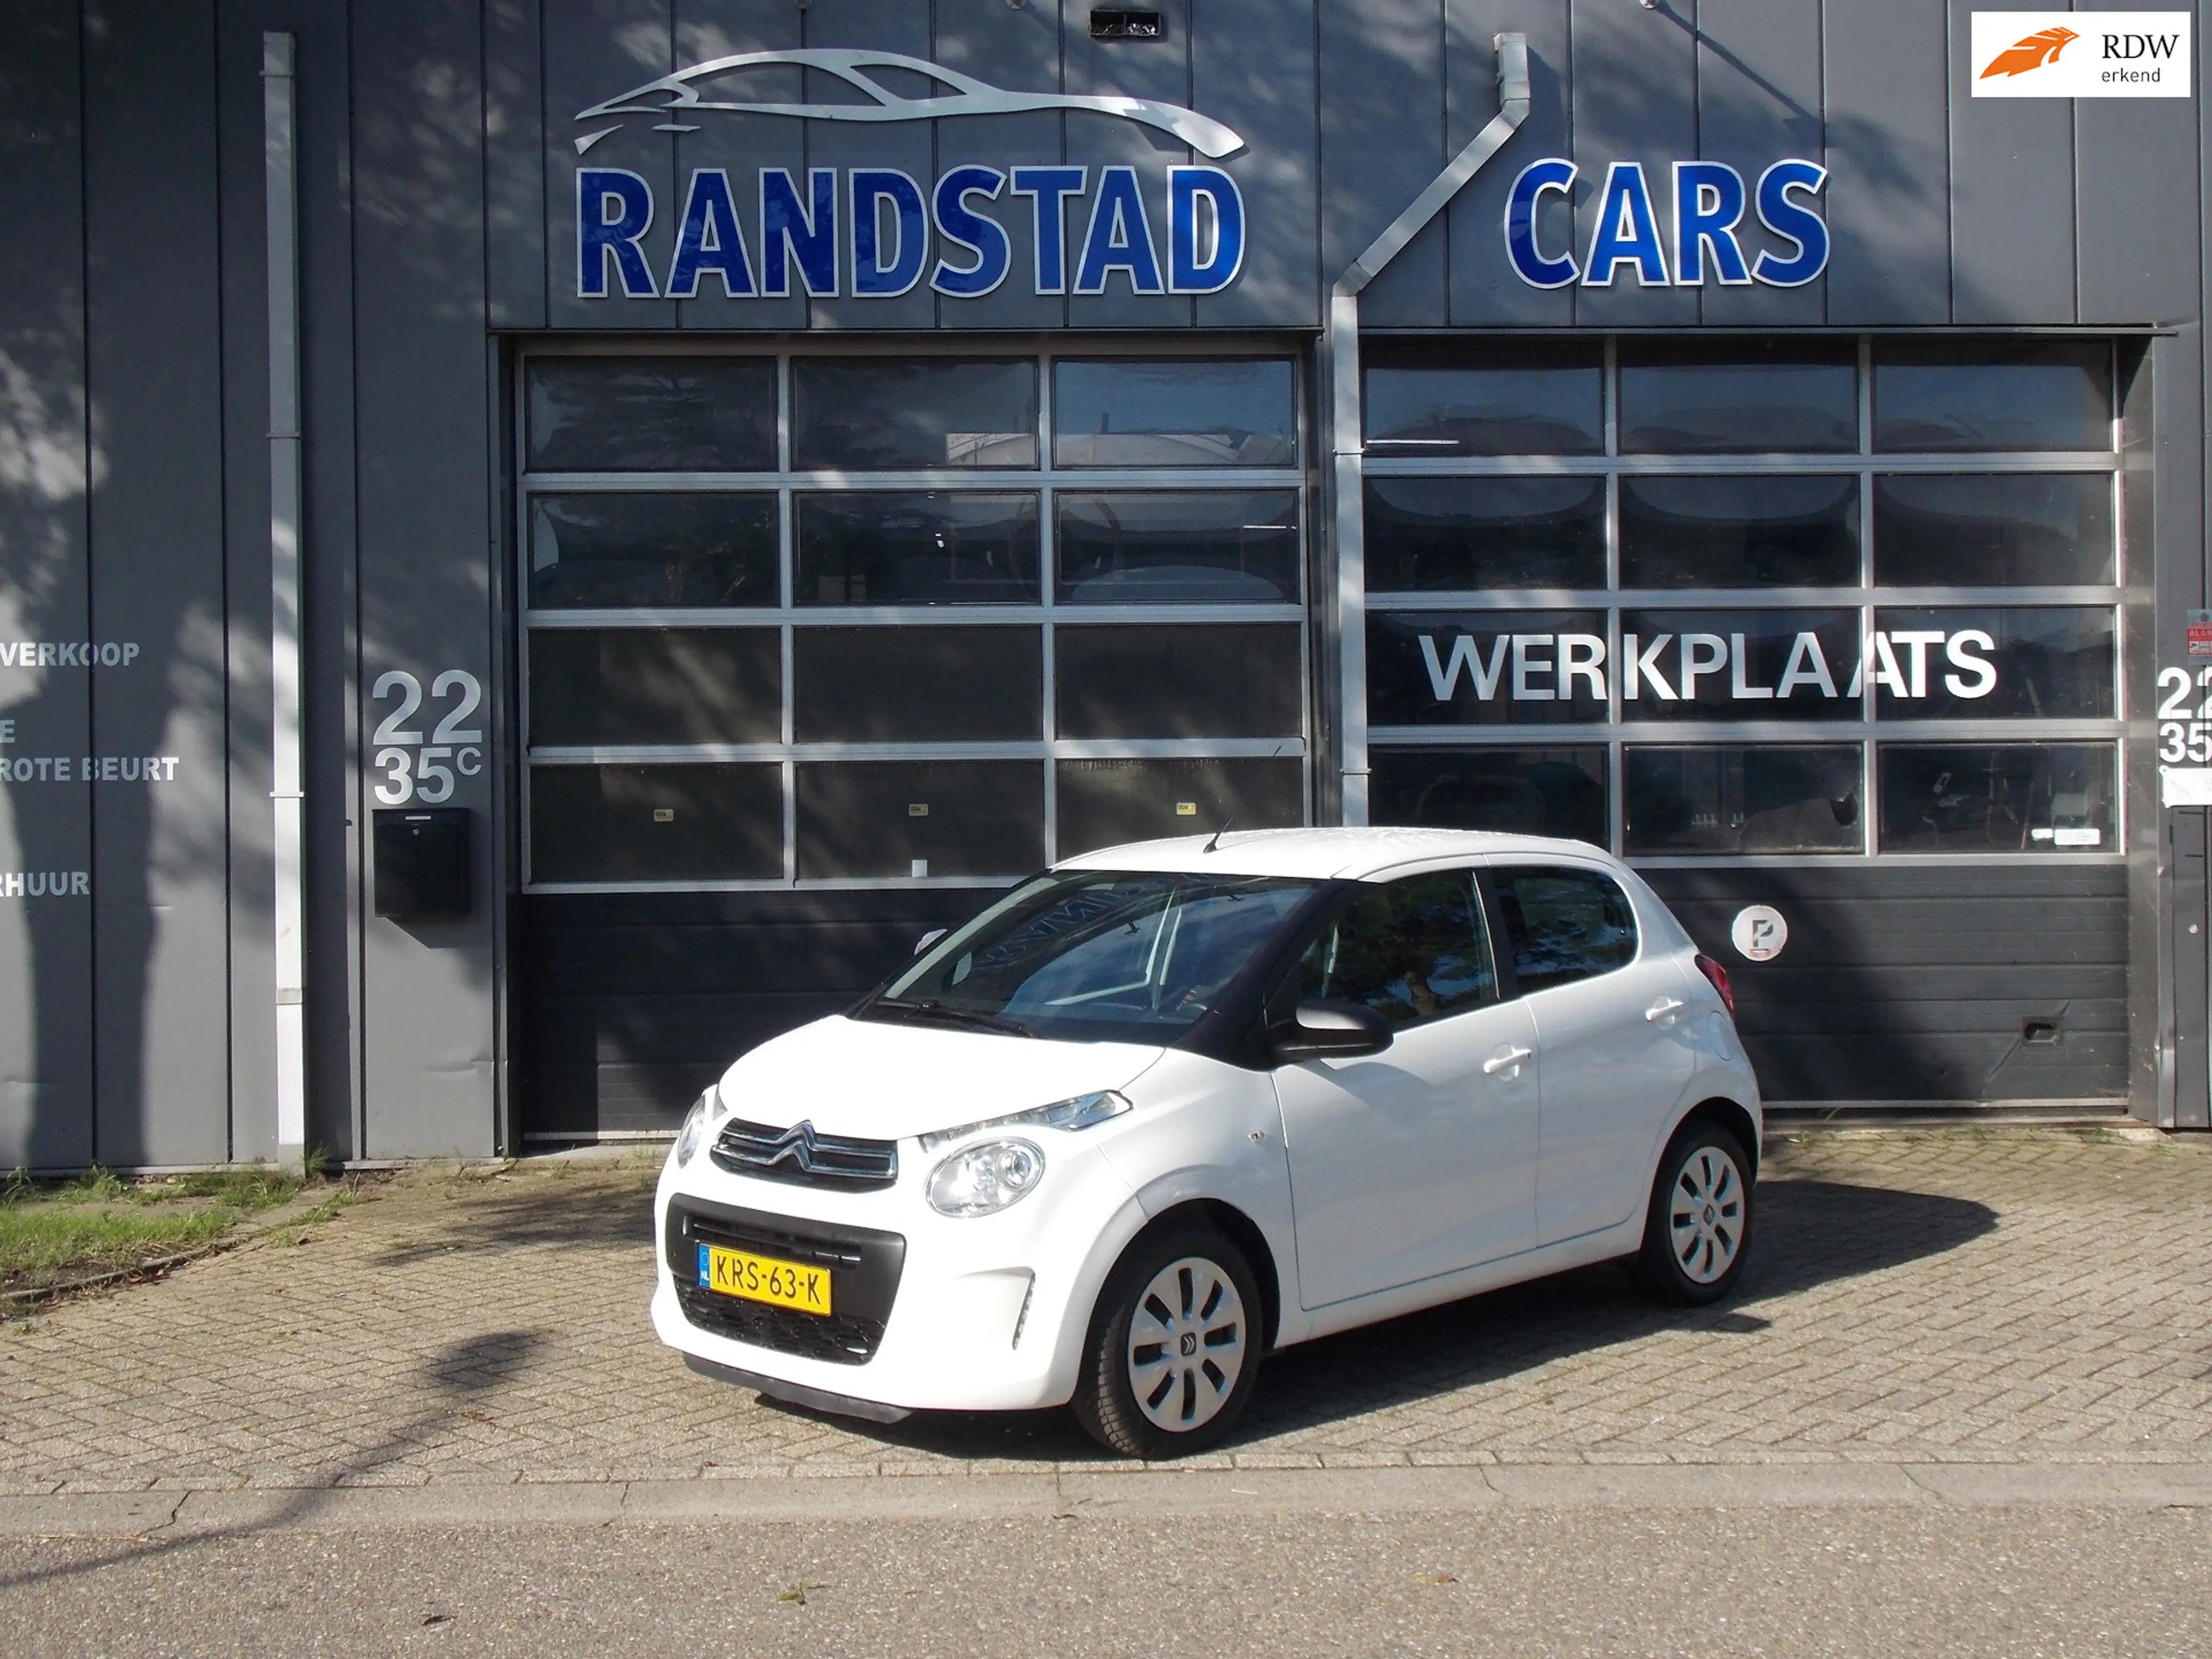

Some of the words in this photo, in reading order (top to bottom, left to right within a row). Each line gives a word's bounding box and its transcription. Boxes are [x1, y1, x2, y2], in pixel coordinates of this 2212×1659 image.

[575, 165, 1246, 298] RANDSTAD
[1504, 158, 1831, 289] CARS
[0, 642, 140, 666] VERKOOP
[1418, 630, 1997, 700] WERKPLAATS
[373, 669, 482, 745] 22
[82, 757, 180, 781] BEURT
[0, 872, 90, 897] HUUR
[717, 1255, 821, 1305] KRS-63-K
